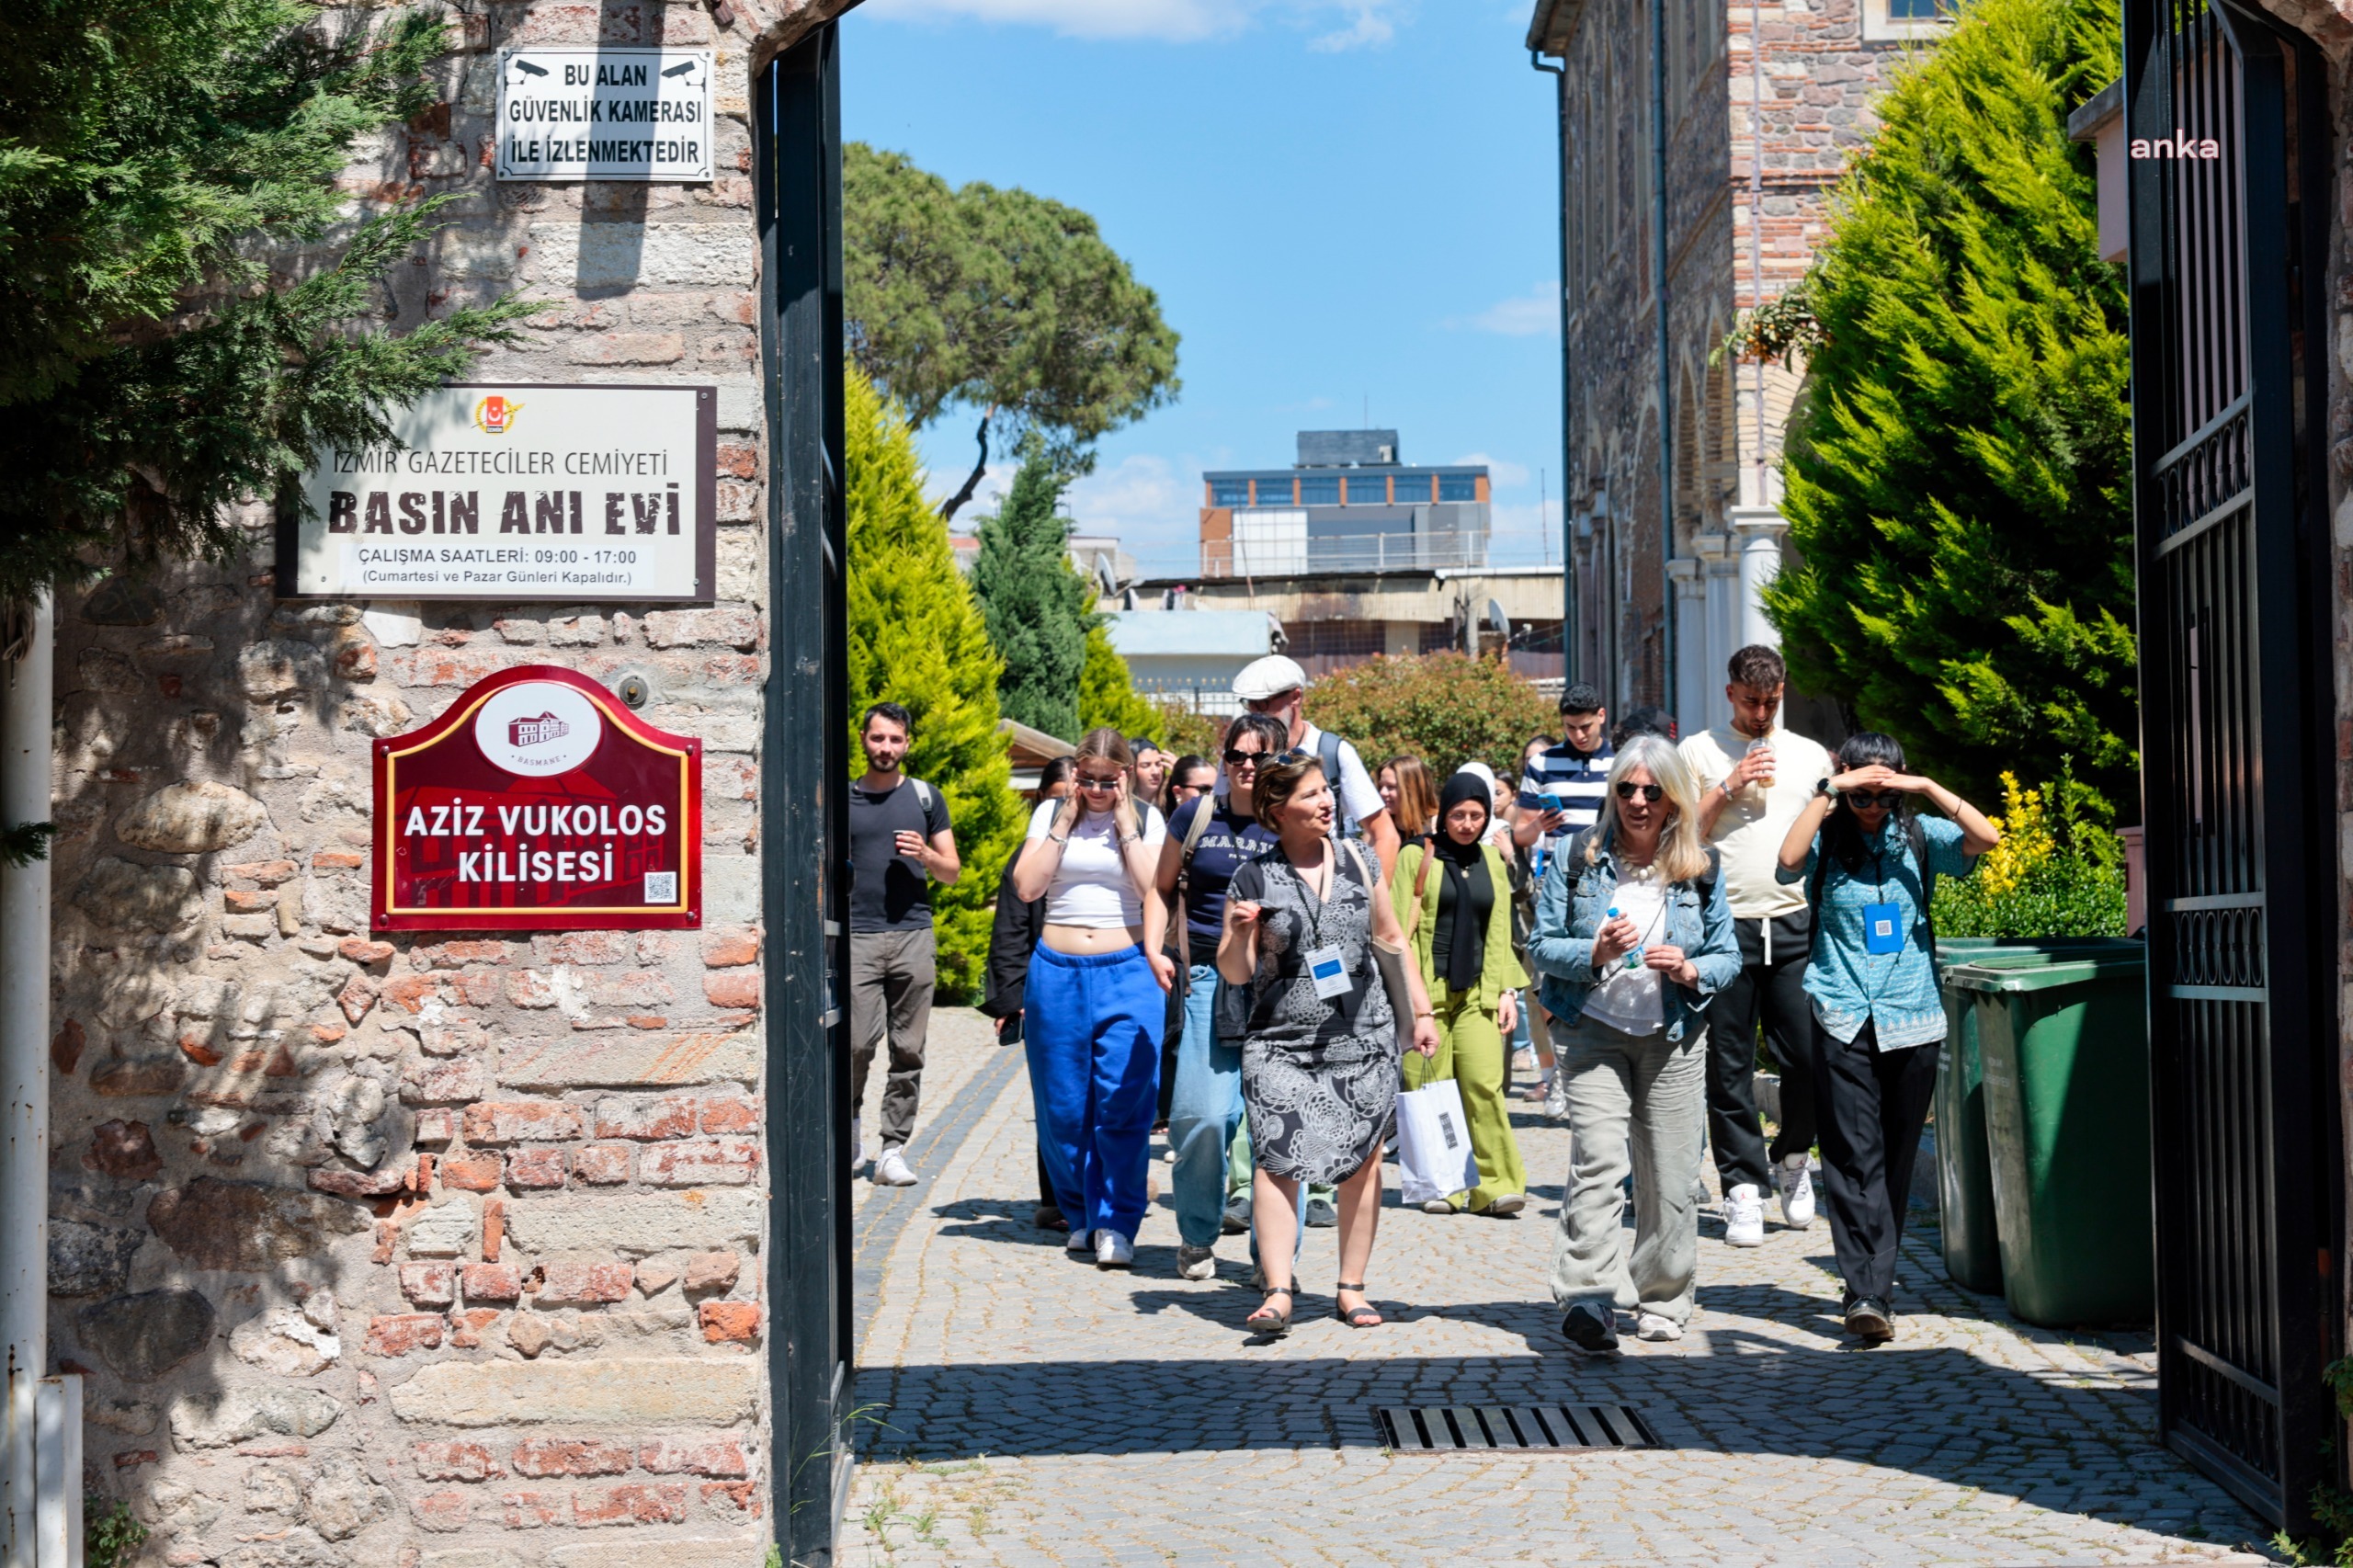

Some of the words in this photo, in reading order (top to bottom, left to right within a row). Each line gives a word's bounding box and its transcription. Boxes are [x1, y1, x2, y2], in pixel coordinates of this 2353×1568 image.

[564, 64, 589, 86] BU
[596, 64, 647, 86] ALAN
[509, 95, 602, 122] GÜVENLİK
[608, 99, 701, 123] KAMERASI
[511, 134, 540, 163] İLE
[546, 134, 699, 164] İZLENMEKTEDİR
[408, 448, 554, 474] GAZETECİLER
[565, 449, 667, 475] CEMİYETİ
[328, 490, 479, 535] BASIN
[499, 490, 583, 535] ANI
[604, 483, 680, 535] EVİ
[358, 549, 436, 565] ÇALIŞMA
[440, 547, 529, 562] SAATLERİ:
[535, 550, 577, 563] 09:00
[594, 551, 636, 564] 17:00
[363, 569, 439, 584] (Cumartesi
[443, 573, 460, 582] ve
[463, 570, 503, 582] Pazar
[506, 571, 557, 583] Günleri
[562, 571, 632, 585] Kapalıdır.)
[517, 756, 561, 767] BASMANE
[404, 797, 484, 836] AZİZ
[497, 804, 667, 836] VUKOLOS
[459, 843, 613, 882] KİLİSESİ
